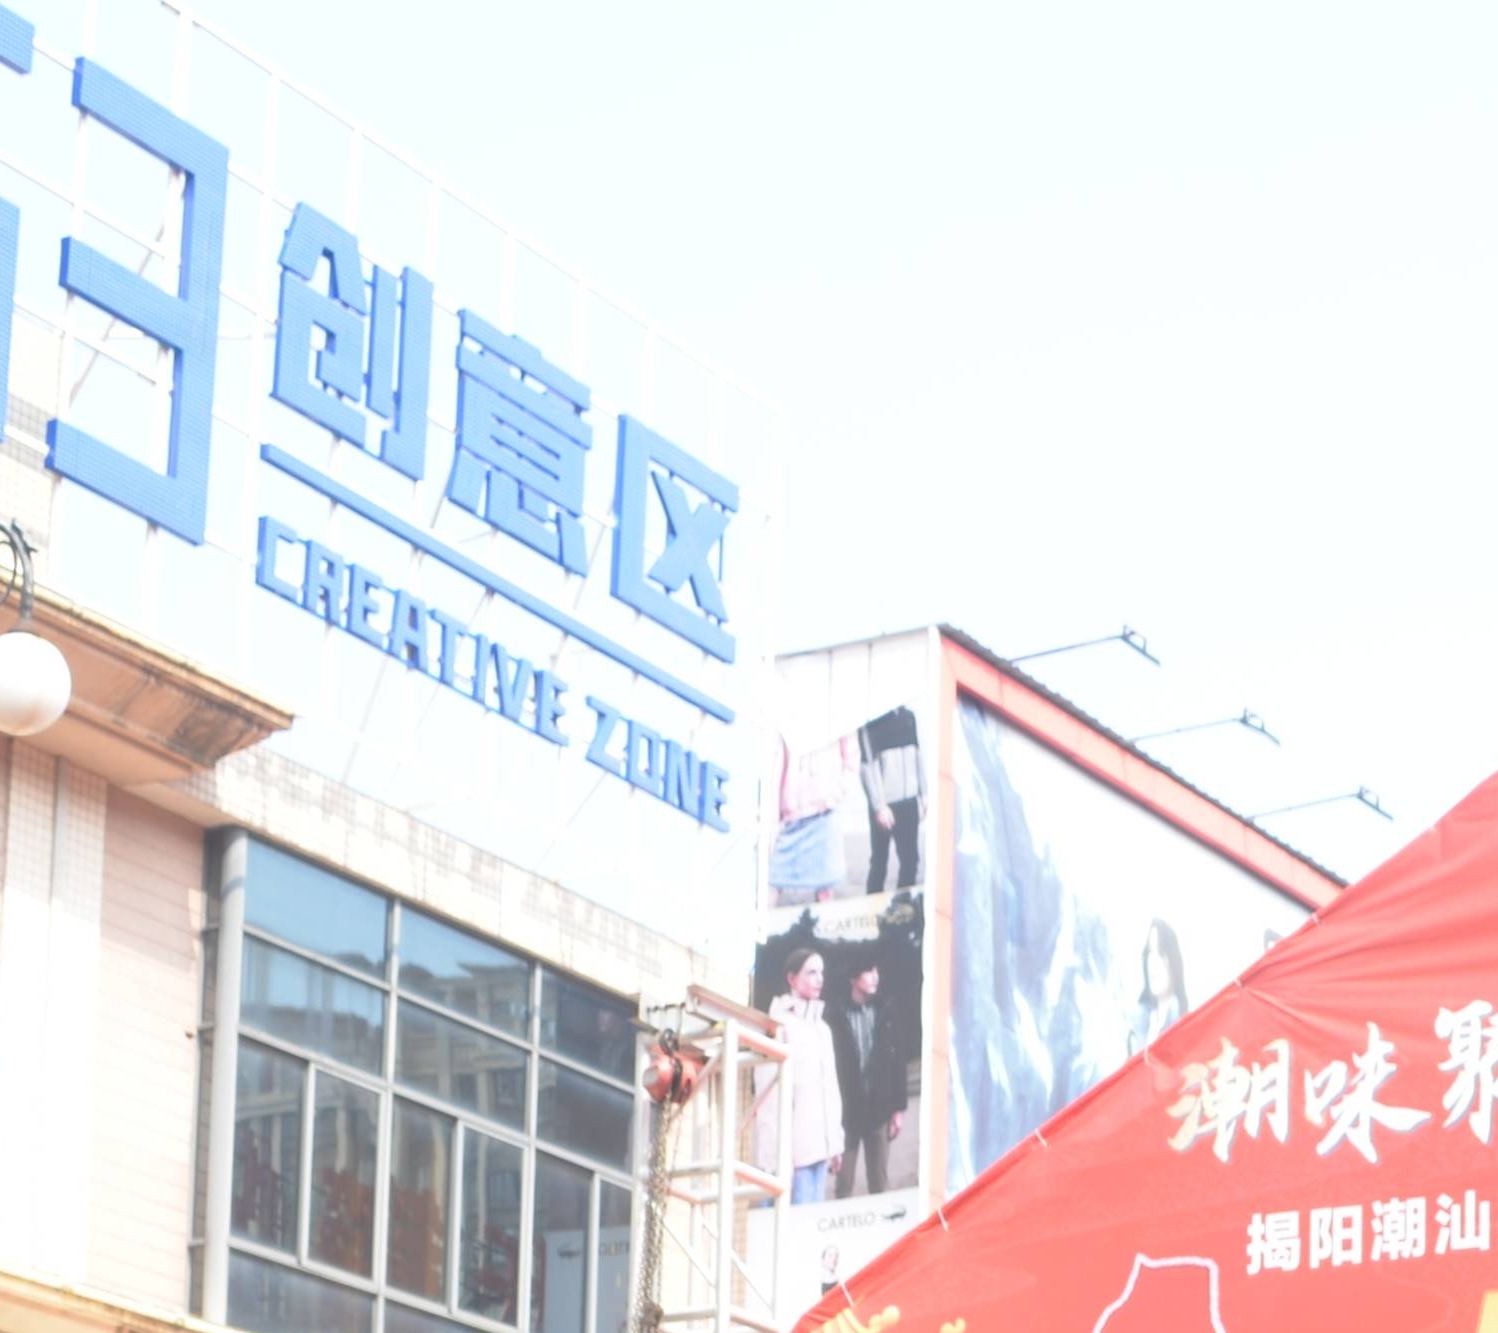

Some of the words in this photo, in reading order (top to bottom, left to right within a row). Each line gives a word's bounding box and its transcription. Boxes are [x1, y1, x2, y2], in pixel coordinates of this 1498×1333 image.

[267, 201, 740, 664] 创意区
[255, 515, 570, 747] CREATIVE
[585, 695, 731, 833] ZONE
[817, 1208, 877, 1233] CARTELO
